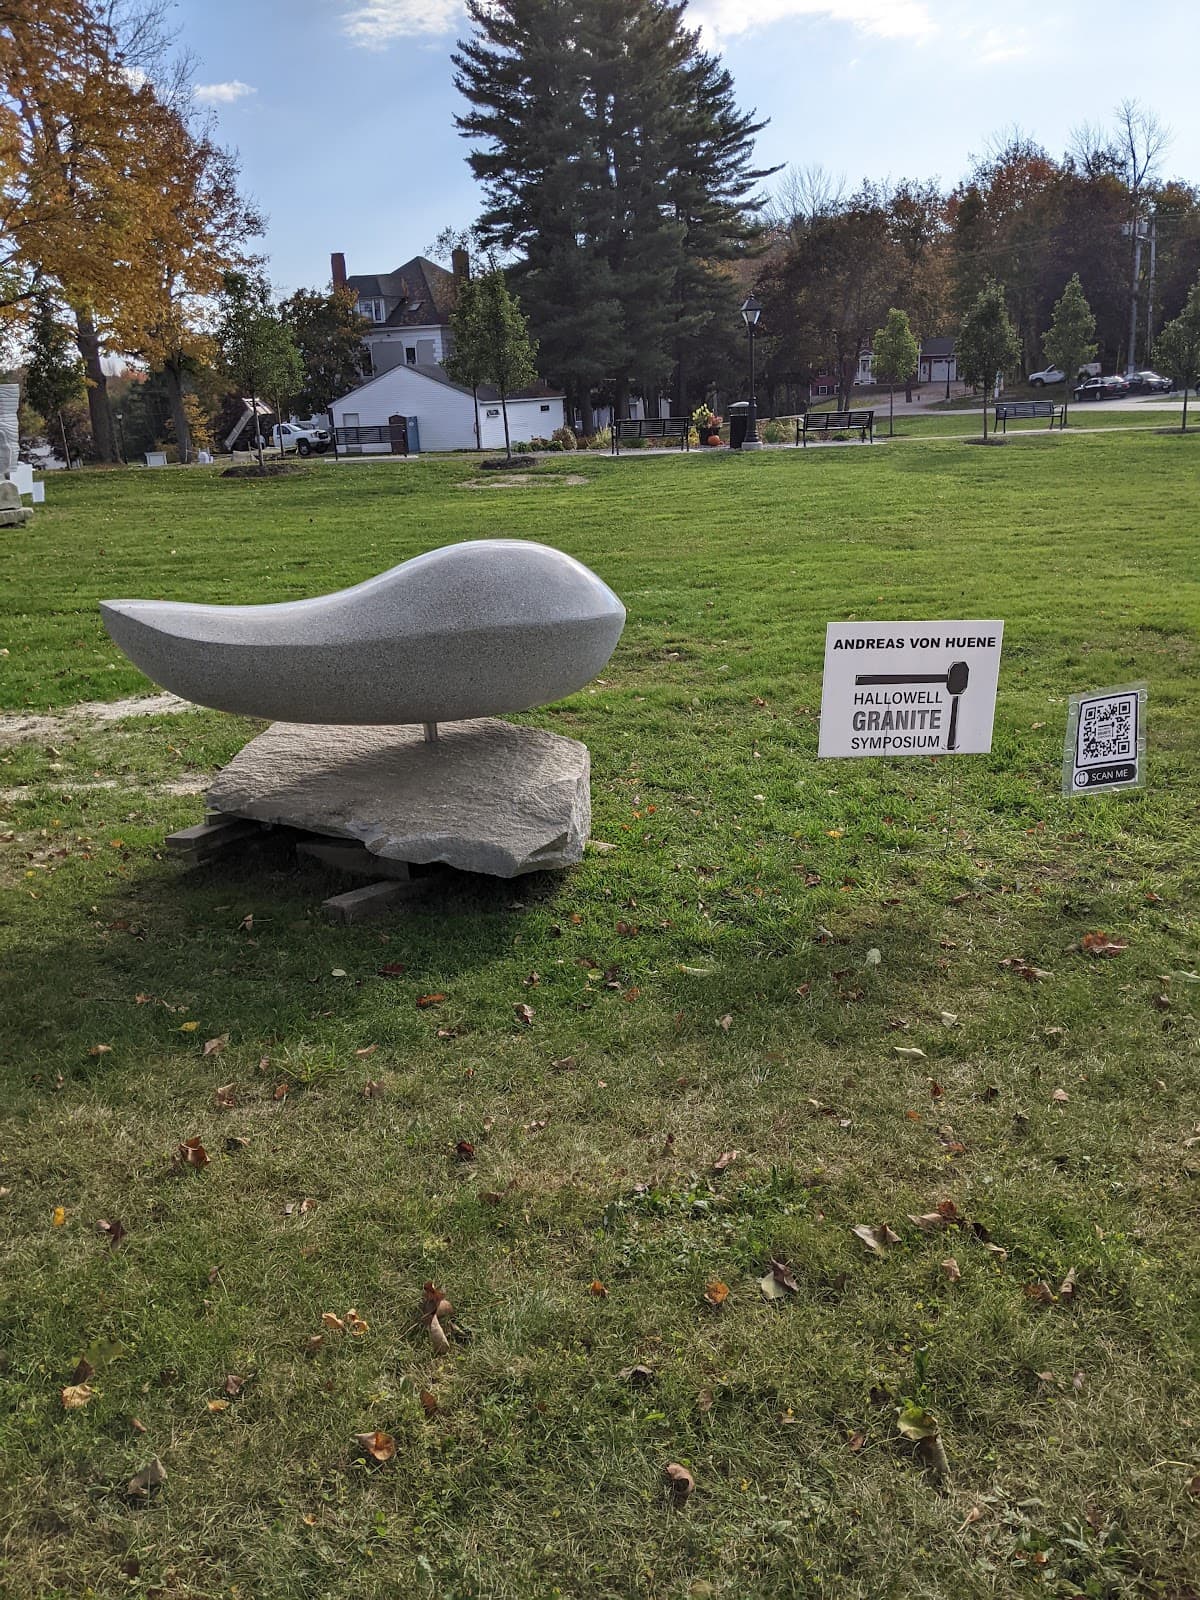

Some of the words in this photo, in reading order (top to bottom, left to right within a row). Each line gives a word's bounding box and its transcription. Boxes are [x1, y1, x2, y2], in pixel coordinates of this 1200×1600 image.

[833, 638, 905, 650] ANDREAS
[910, 637, 941, 649] VON
[945, 637, 996, 648] HUENE
[854, 691, 943, 705] HALLOWELL
[852, 709, 942, 731] GRANITE
[851, 735, 940, 750] SYMPOSIUM
[1091, 770, 1114, 781] SCAN
[1115, 768, 1129, 778] ME
